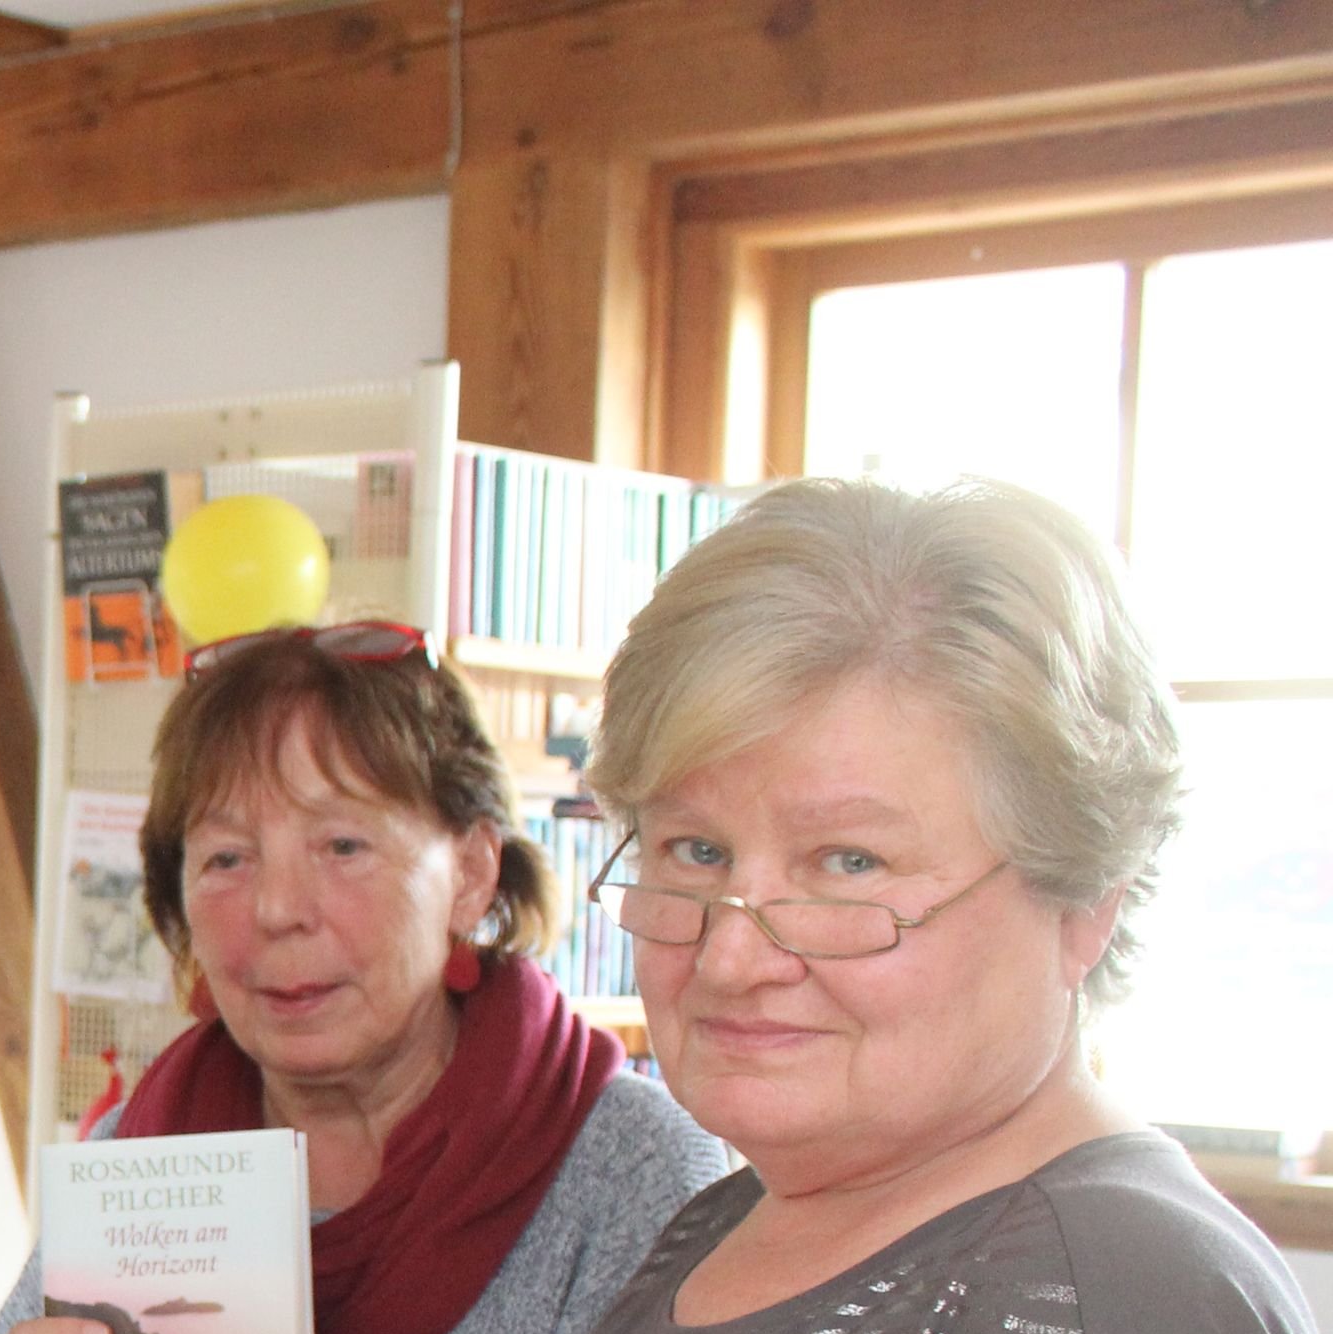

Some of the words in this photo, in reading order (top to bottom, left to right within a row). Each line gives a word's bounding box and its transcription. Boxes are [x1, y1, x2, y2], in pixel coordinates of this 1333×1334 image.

[70, 1152, 254, 1183] ROSAMUNDE
[100, 1185, 225, 1213] PILCHER
[105, 1222, 188, 1249] Wolken
[195, 1226, 228, 1244] am
[116, 1256, 217, 1279] Horizont
